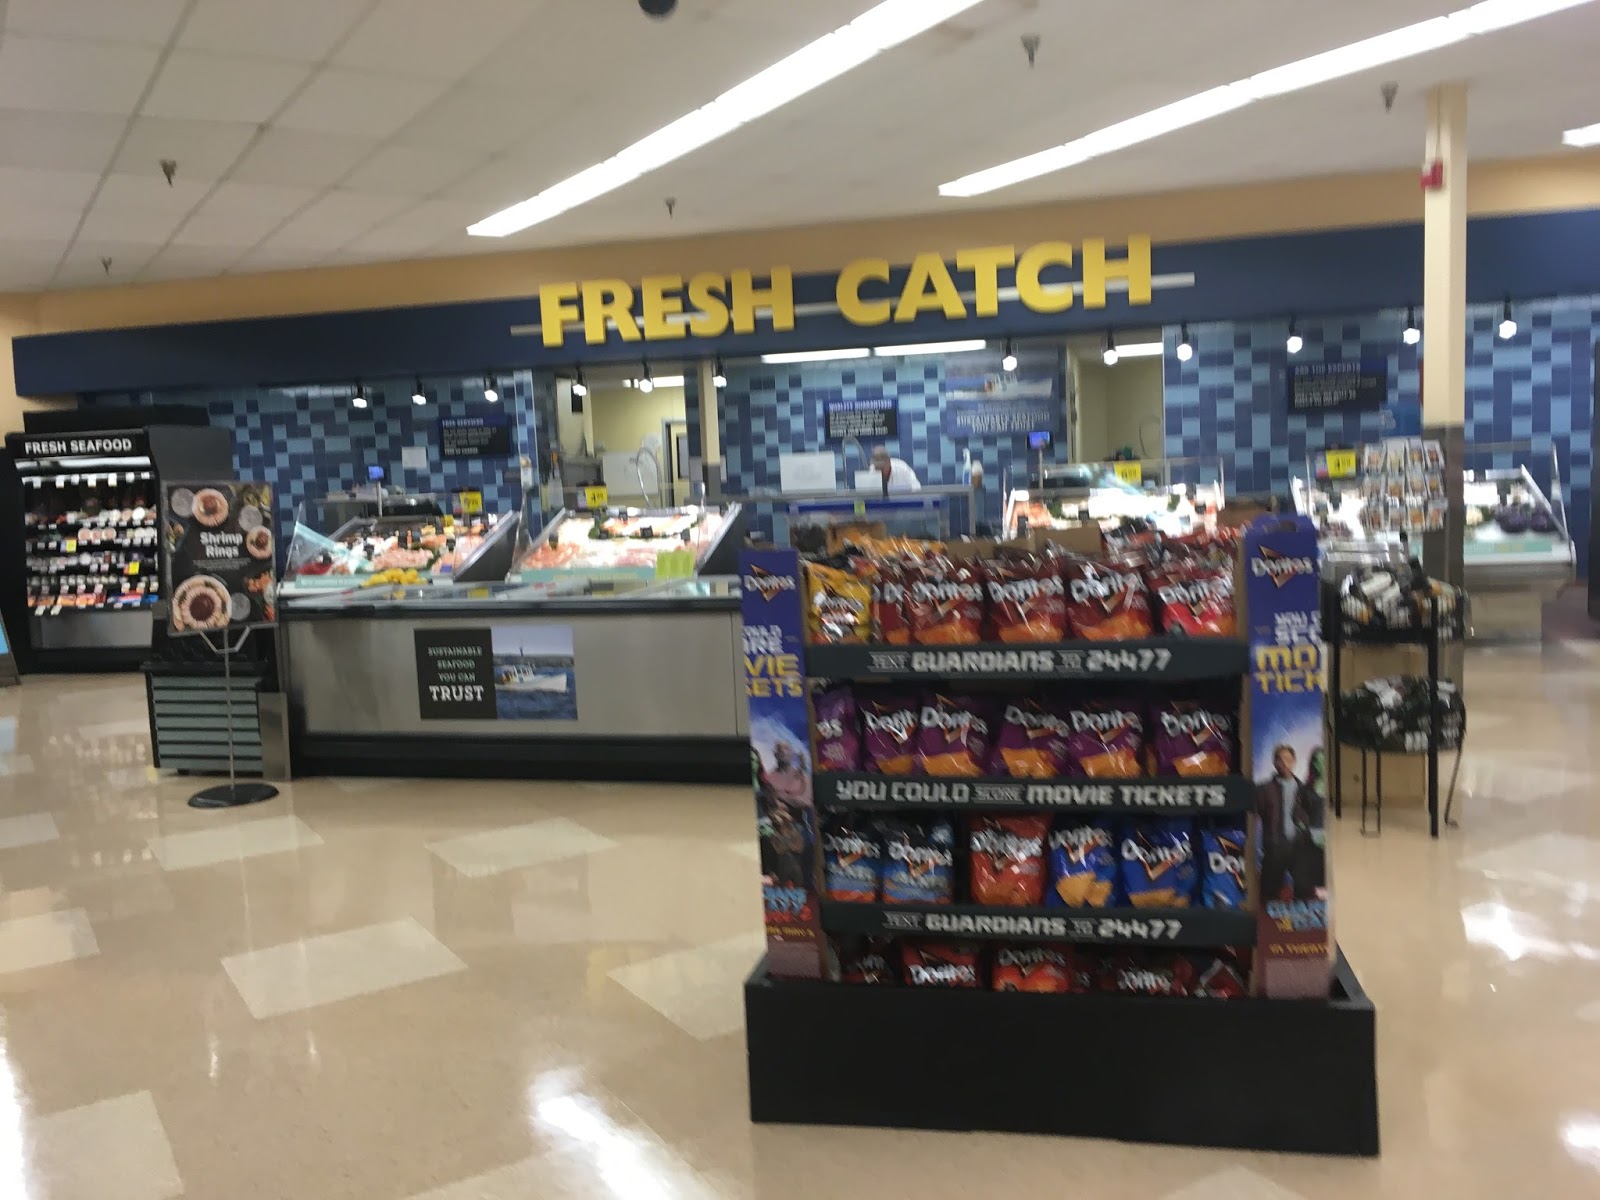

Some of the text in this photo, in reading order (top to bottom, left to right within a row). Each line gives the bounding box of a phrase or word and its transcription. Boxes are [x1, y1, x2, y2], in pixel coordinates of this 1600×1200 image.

[539, 233, 1152, 347] FRESH CATCH
[25, 438, 132, 454] FRESH SEAFOOD
[200, 531, 243, 546] Shrimp
[206, 545, 239, 559] Rings
[428, 646, 483, 657] SUSTAINABLE
[437, 659, 476, 670] SEAFOOD
[911, 650, 1065, 673] GUARDIANS
[1086, 648, 1172, 672] 24477
[438, 672, 476, 683] YOU CAN
[429, 685, 485, 702] TRUST
[836, 780, 1227, 807] YOU COULD SCORE MOVIE TICKETS
[925, 913, 1066, 936] GUARDIANS
[1099, 918, 1183, 941] 24477
